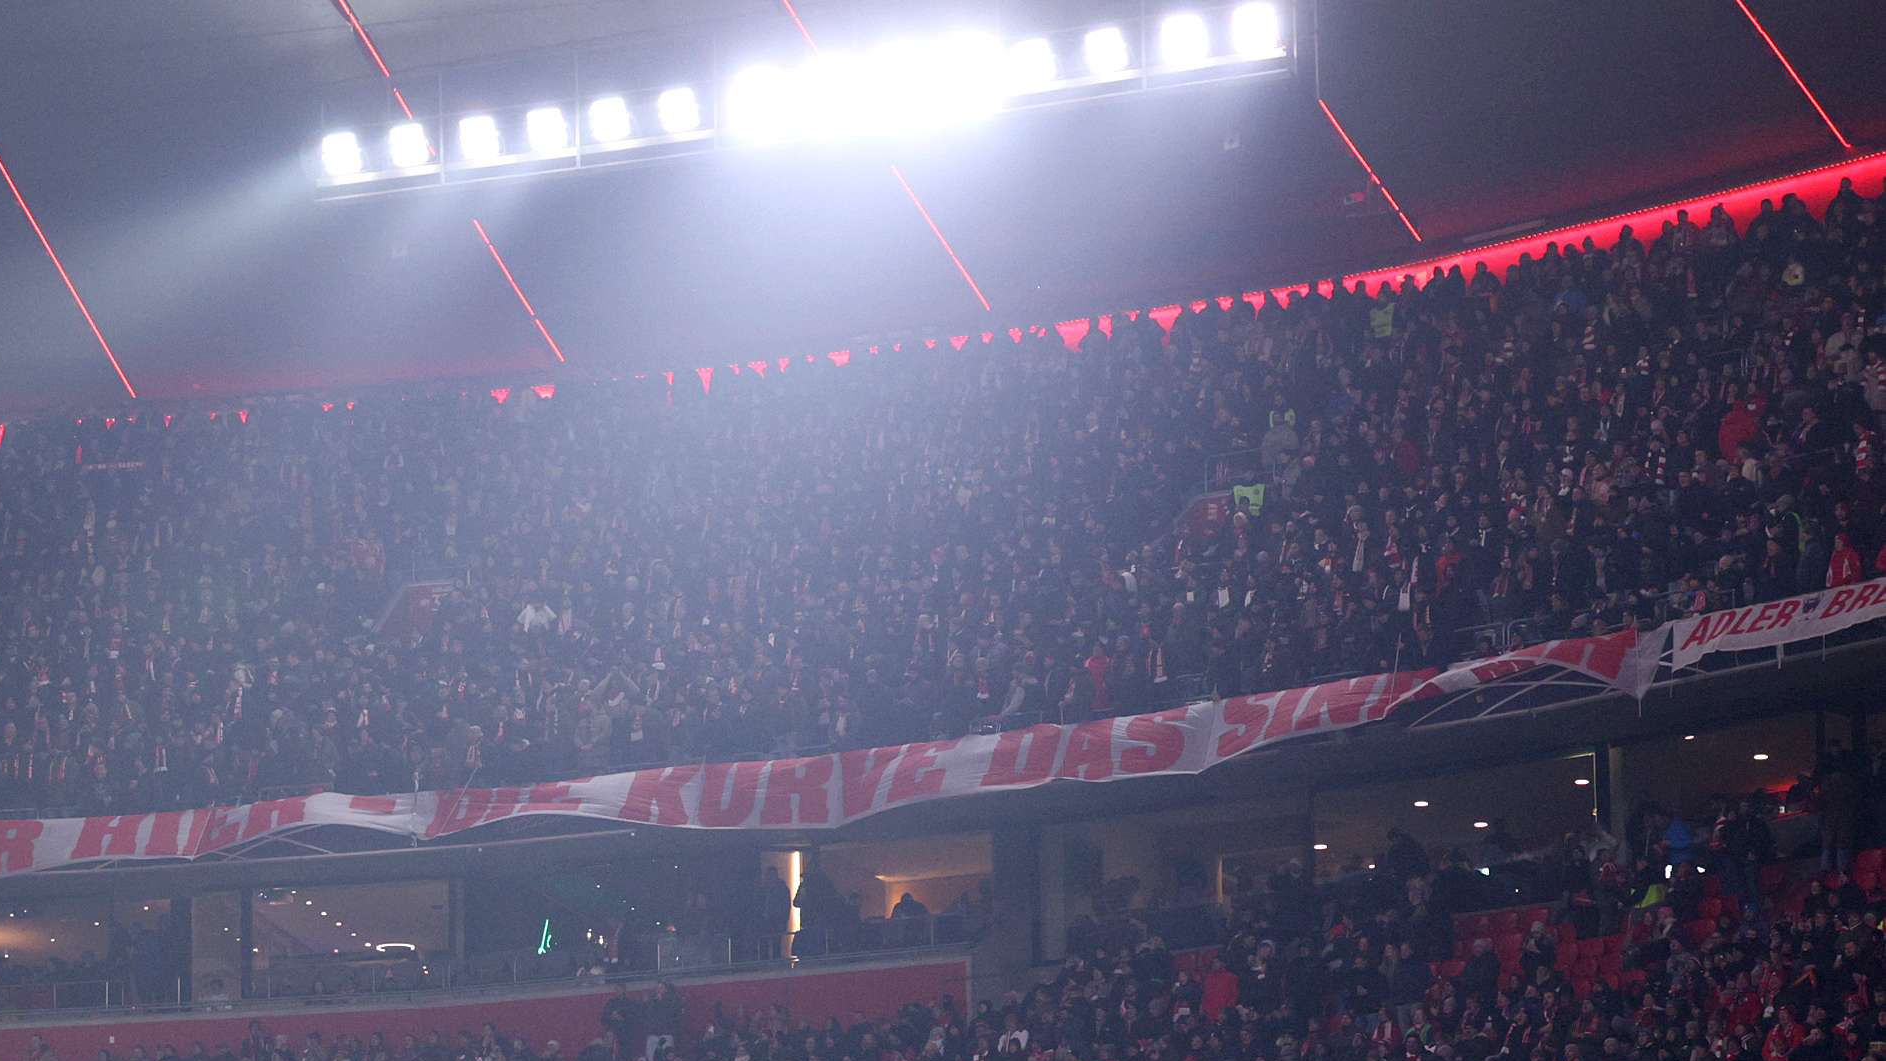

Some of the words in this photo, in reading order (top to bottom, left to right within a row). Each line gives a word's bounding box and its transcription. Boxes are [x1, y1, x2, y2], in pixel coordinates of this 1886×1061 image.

[1681, 600, 1802, 650] ADLER
[619, 739, 962, 827] KURVE
[980, 707, 1187, 787] DAS
